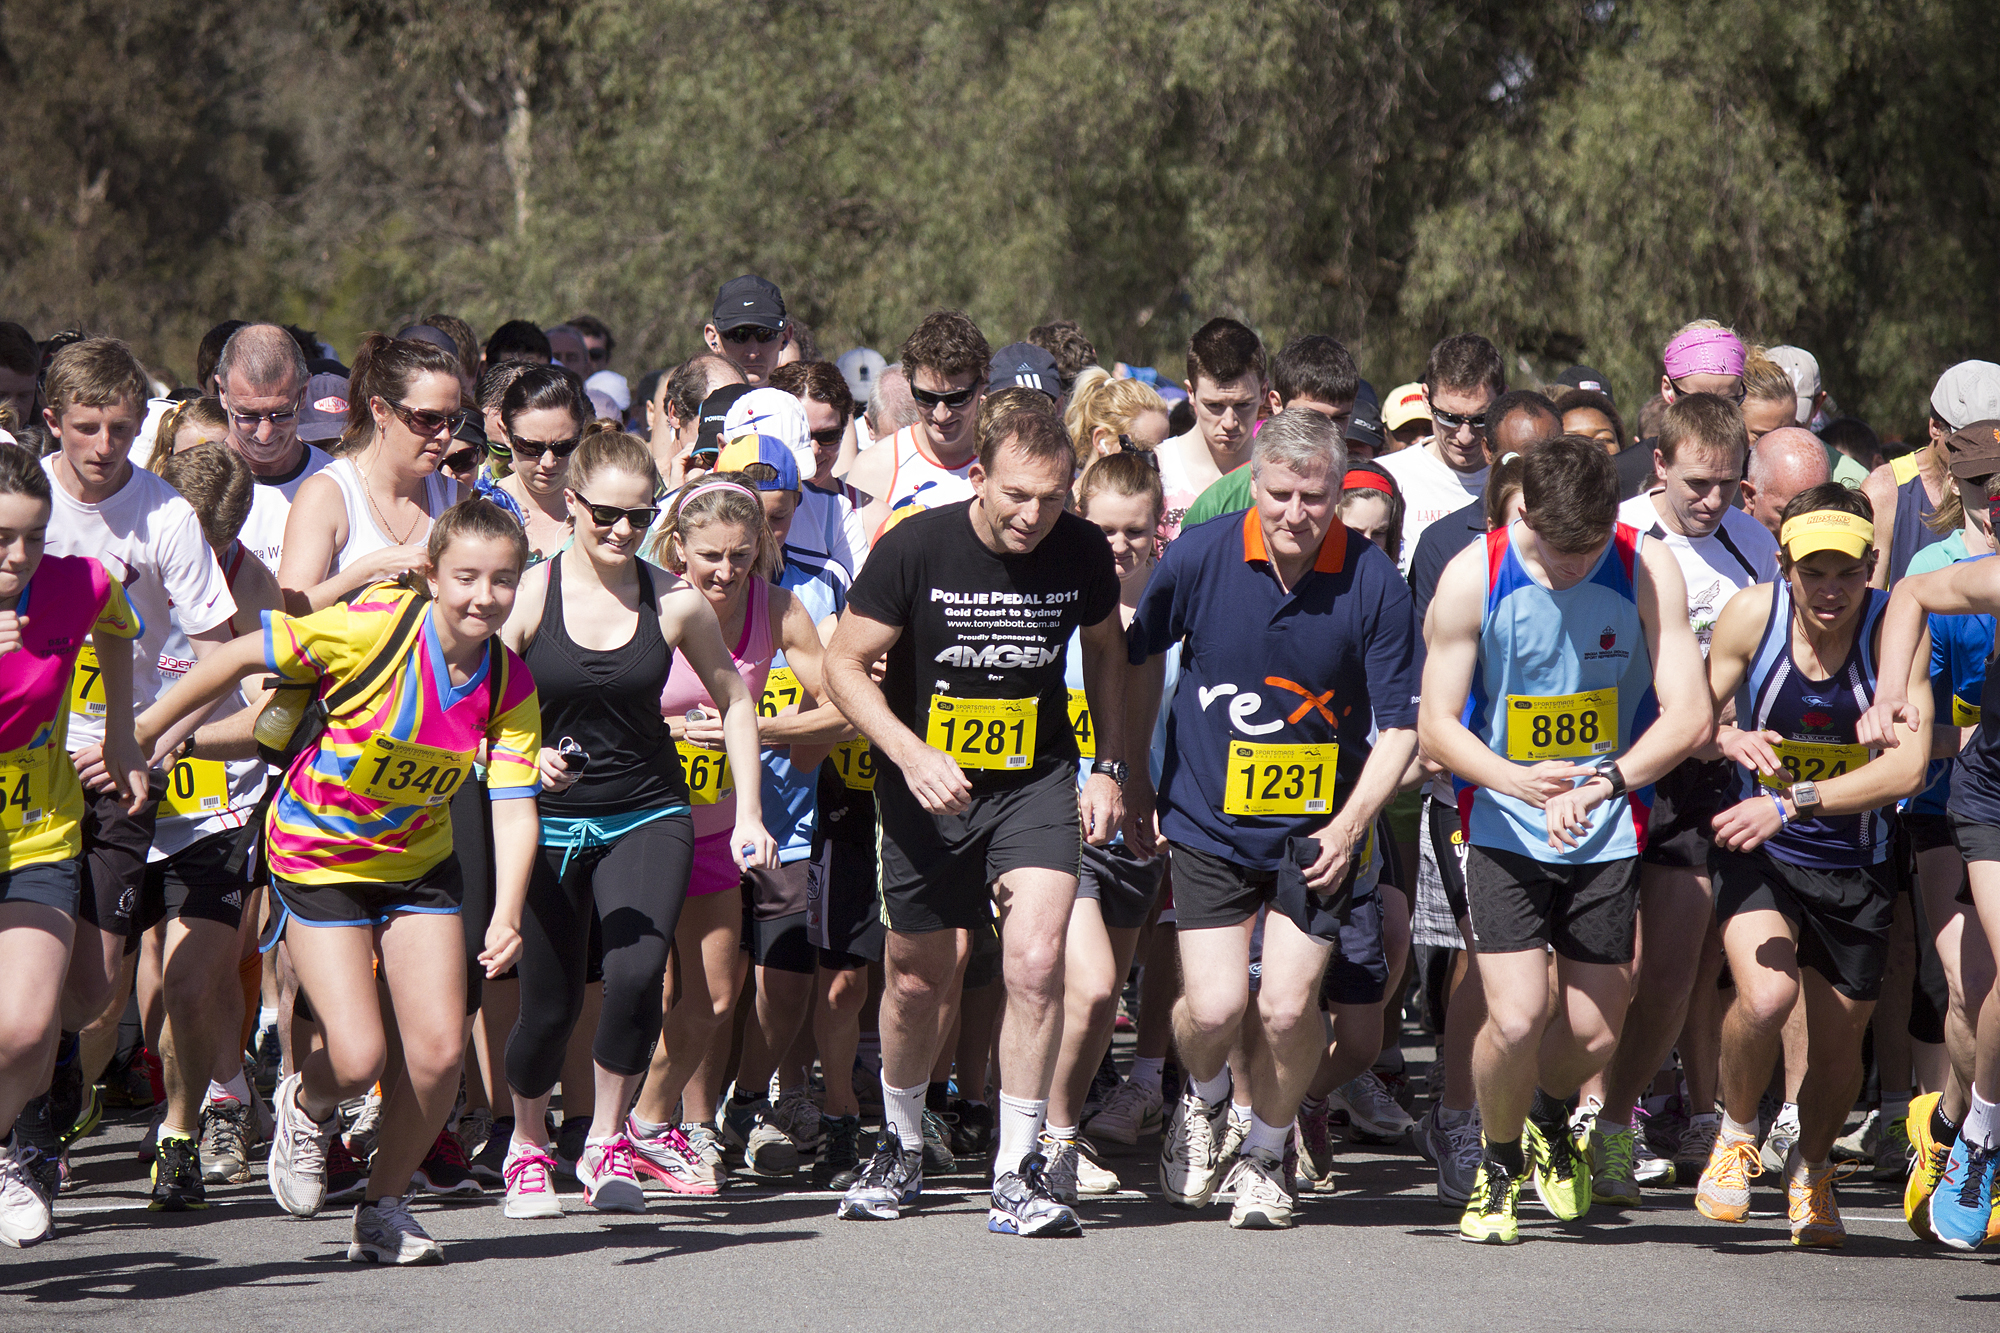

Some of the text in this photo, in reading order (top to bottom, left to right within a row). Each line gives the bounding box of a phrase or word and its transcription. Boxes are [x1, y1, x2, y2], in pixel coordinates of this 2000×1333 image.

[1354, 418, 1376, 431] 2XU
[1807, 514, 1851, 524] KIDSONS
[930, 588, 1079, 605] POLLIE PEDAL 2011
[945, 607, 1062, 619] Gold Coast to Sydney
[947, 619, 1060, 629] www.tonyabbott.com.au
[957, 633, 1047, 643] Proudly Sponsored by
[934, 644, 1062, 669] AMGEN
[988, 673, 1004, 682] for
[940, 717, 1025, 755] 1281
[1532, 710, 1599, 748] 888
[838, 747, 878, 779] 19
[1782, 755, 1847, 783] 824
[370, 755, 461, 795] 1340
[1240, 763, 1324, 800] 1231
